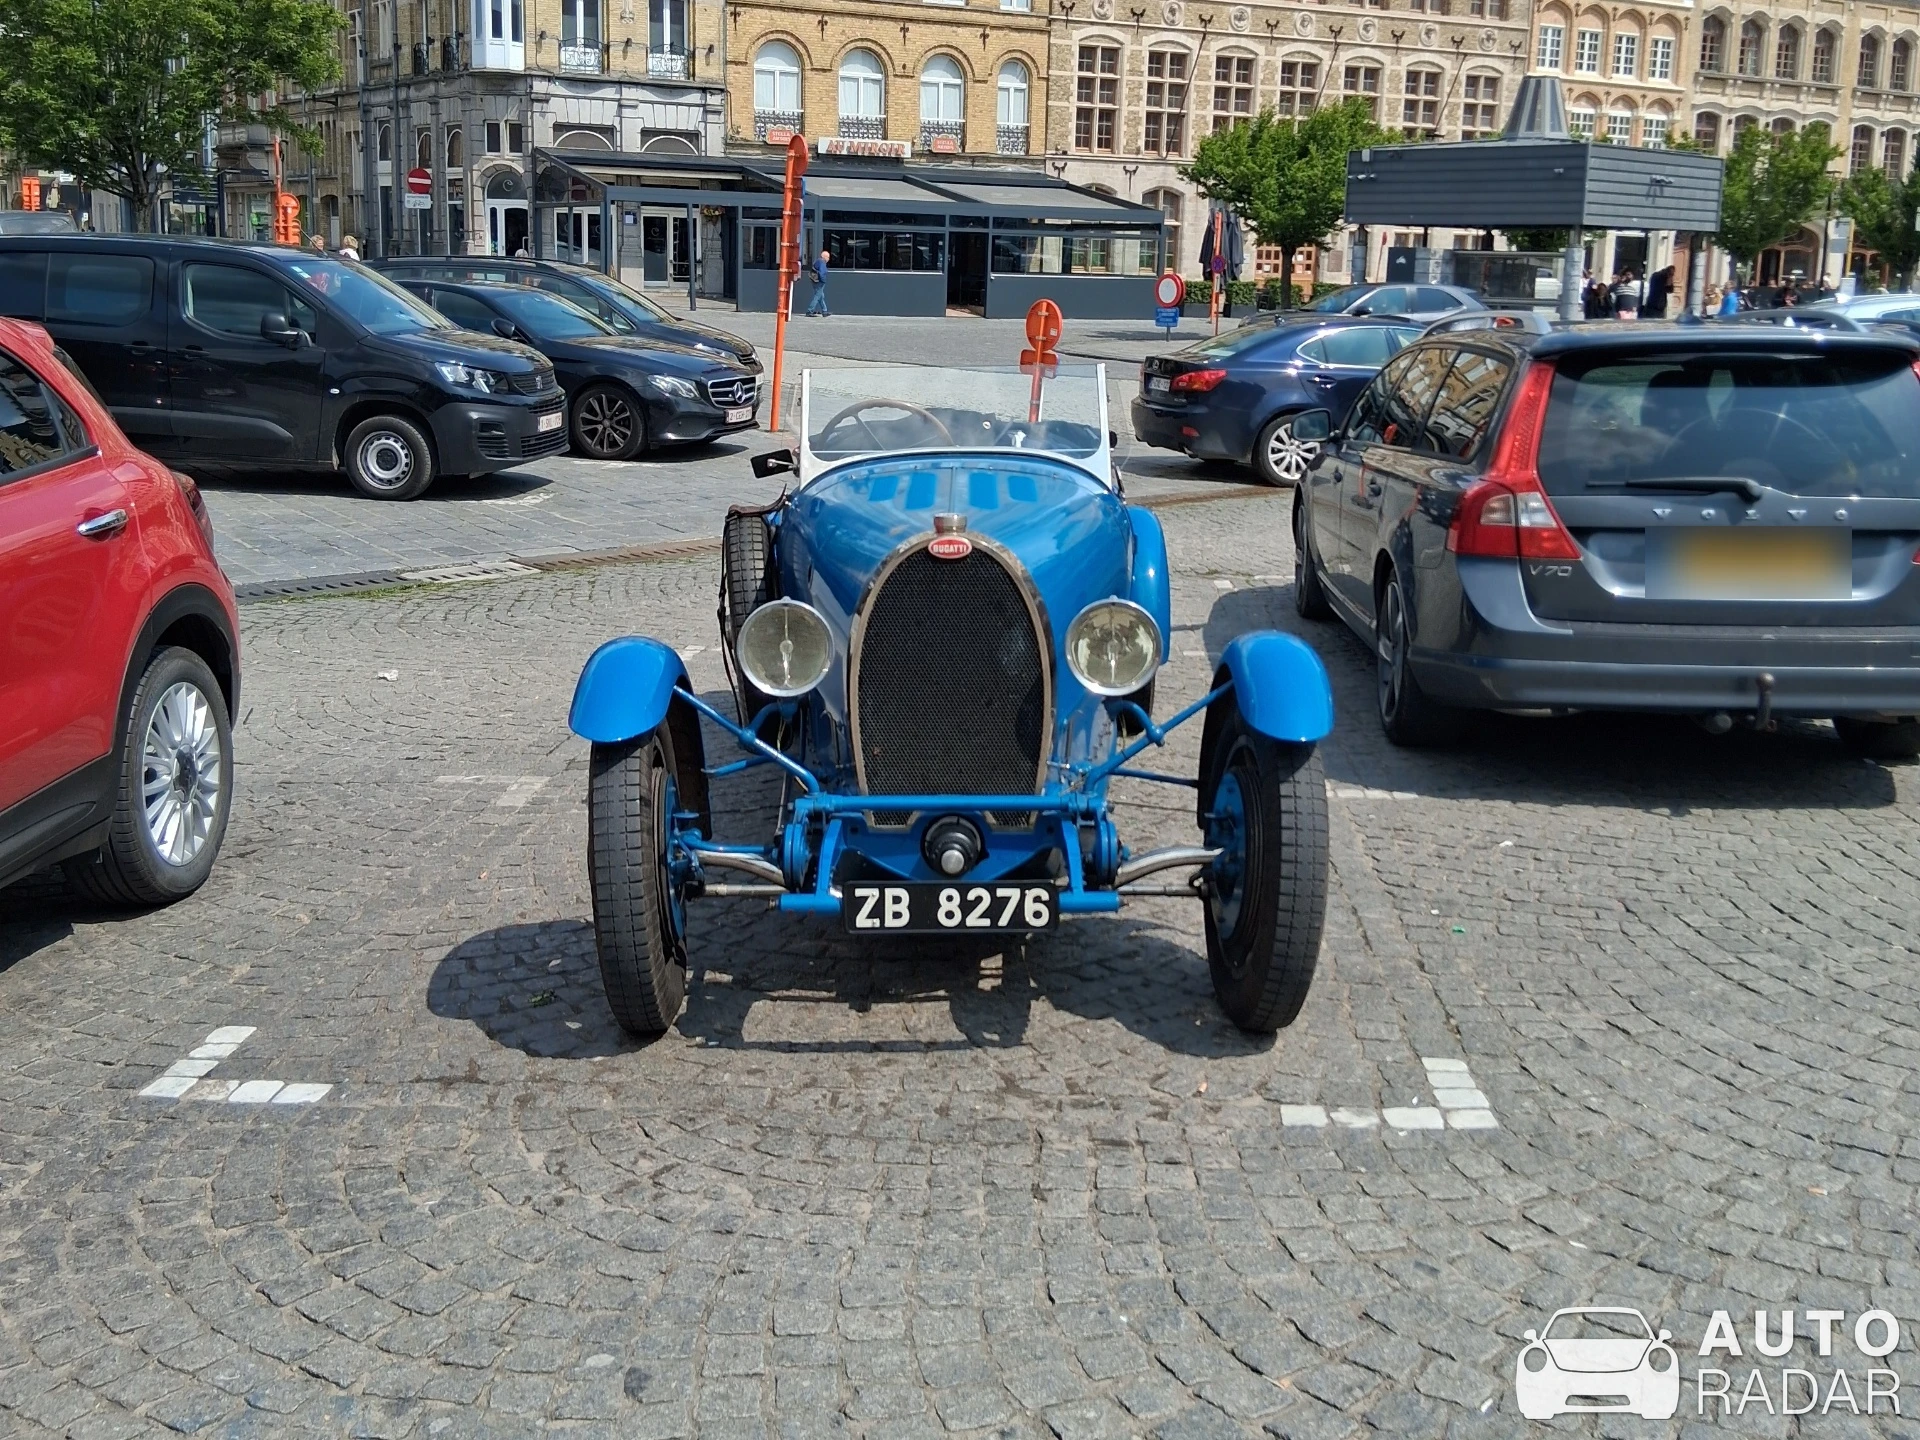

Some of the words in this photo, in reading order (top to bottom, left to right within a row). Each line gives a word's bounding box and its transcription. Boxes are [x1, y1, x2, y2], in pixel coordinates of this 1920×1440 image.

[826, 140, 846, 152] AU
[849, 141, 905, 155] MIROIR
[1652, 507, 1849, 521] VOLVO
[932, 544, 967, 554] BUGATTI
[1529, 564, 1573, 577] V70
[854, 887, 911, 928] ZB
[937, 887, 1050, 927] 8276
